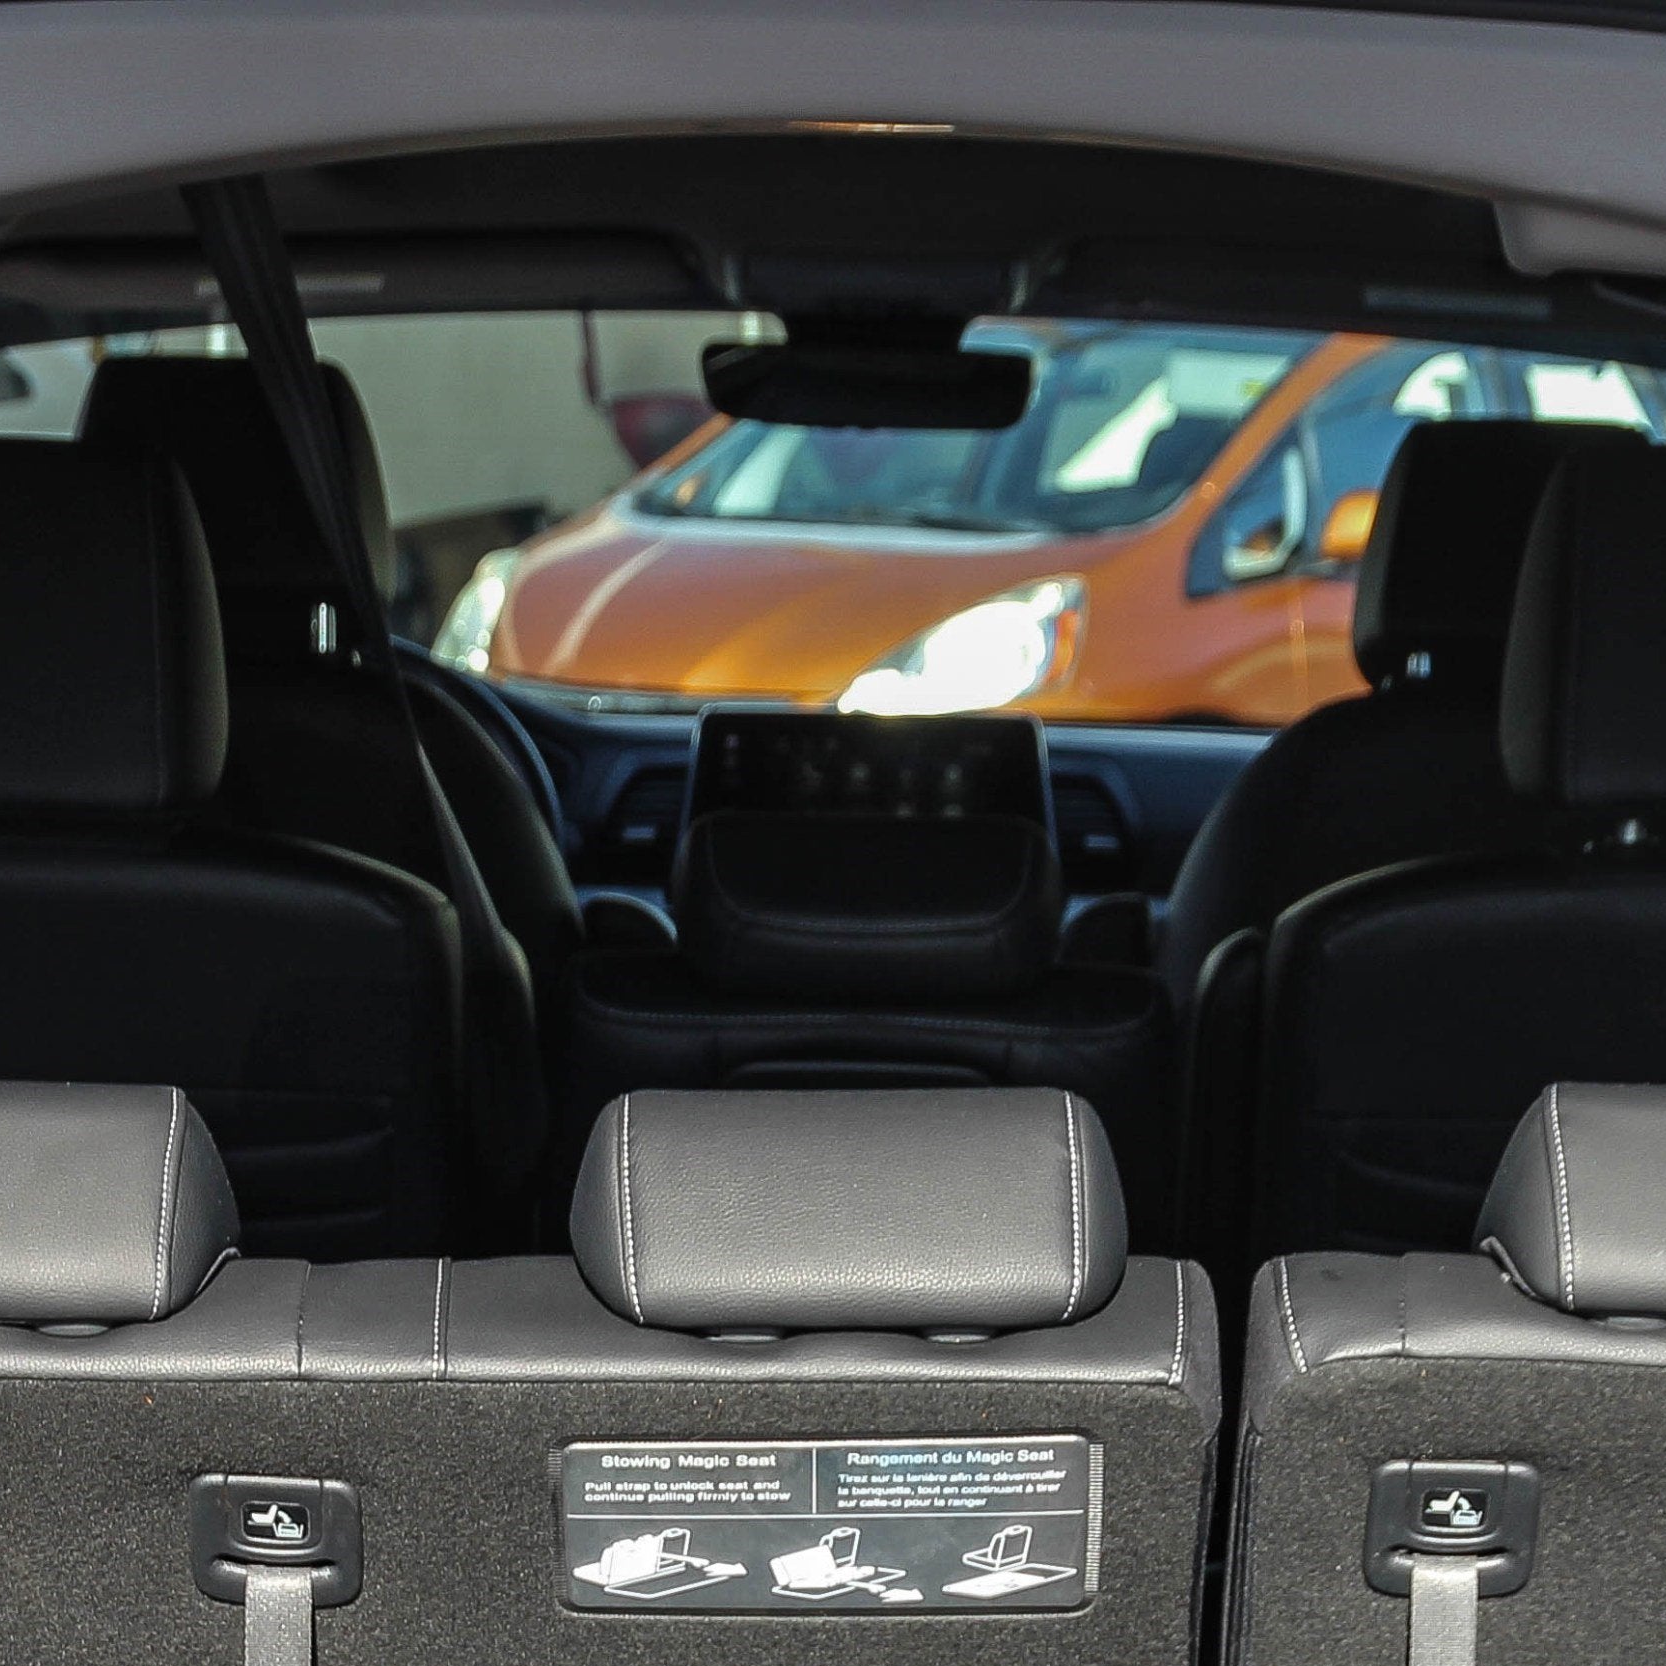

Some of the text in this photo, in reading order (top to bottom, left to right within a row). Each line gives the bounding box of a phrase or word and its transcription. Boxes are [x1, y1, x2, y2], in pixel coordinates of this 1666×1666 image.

[601, 1454, 776, 1470] Stowing Magic Seat
[846, 1449, 1055, 1467] Rangement du Magic Seat
[950, 1472, 973, 1482] afin
[975, 1472, 990, 1481] de
[585, 1480, 780, 1493] Pull strap to unlock seat and
[943, 1486, 959, 1494] en
[584, 1492, 791, 1503] continue pulling firmly to stow
[904, 1498, 932, 1508] pour
